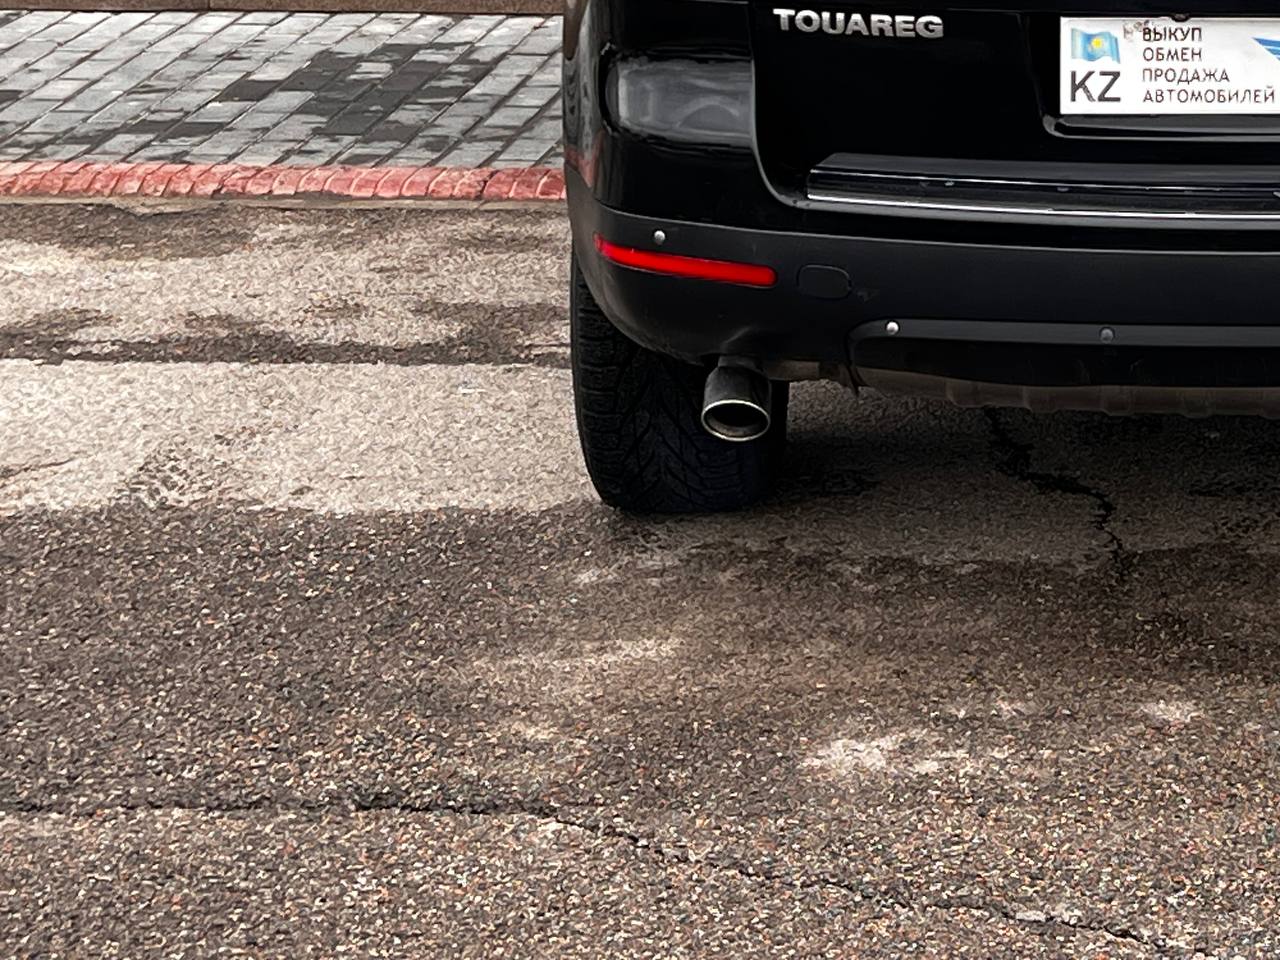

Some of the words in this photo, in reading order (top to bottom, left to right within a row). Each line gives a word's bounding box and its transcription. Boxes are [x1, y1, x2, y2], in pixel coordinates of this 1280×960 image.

[773, 8, 944, 39] TOUAREG
[1142, 27, 1202, 42] ВЫКУП
[1142, 47, 1202, 62] ОБМЕН
[1142, 67, 1230, 84] ПРОДАЖА
[1070, 70, 1122, 103] KZ
[1142, 86, 1275, 104] АВТОМОБИЛЕЙ
